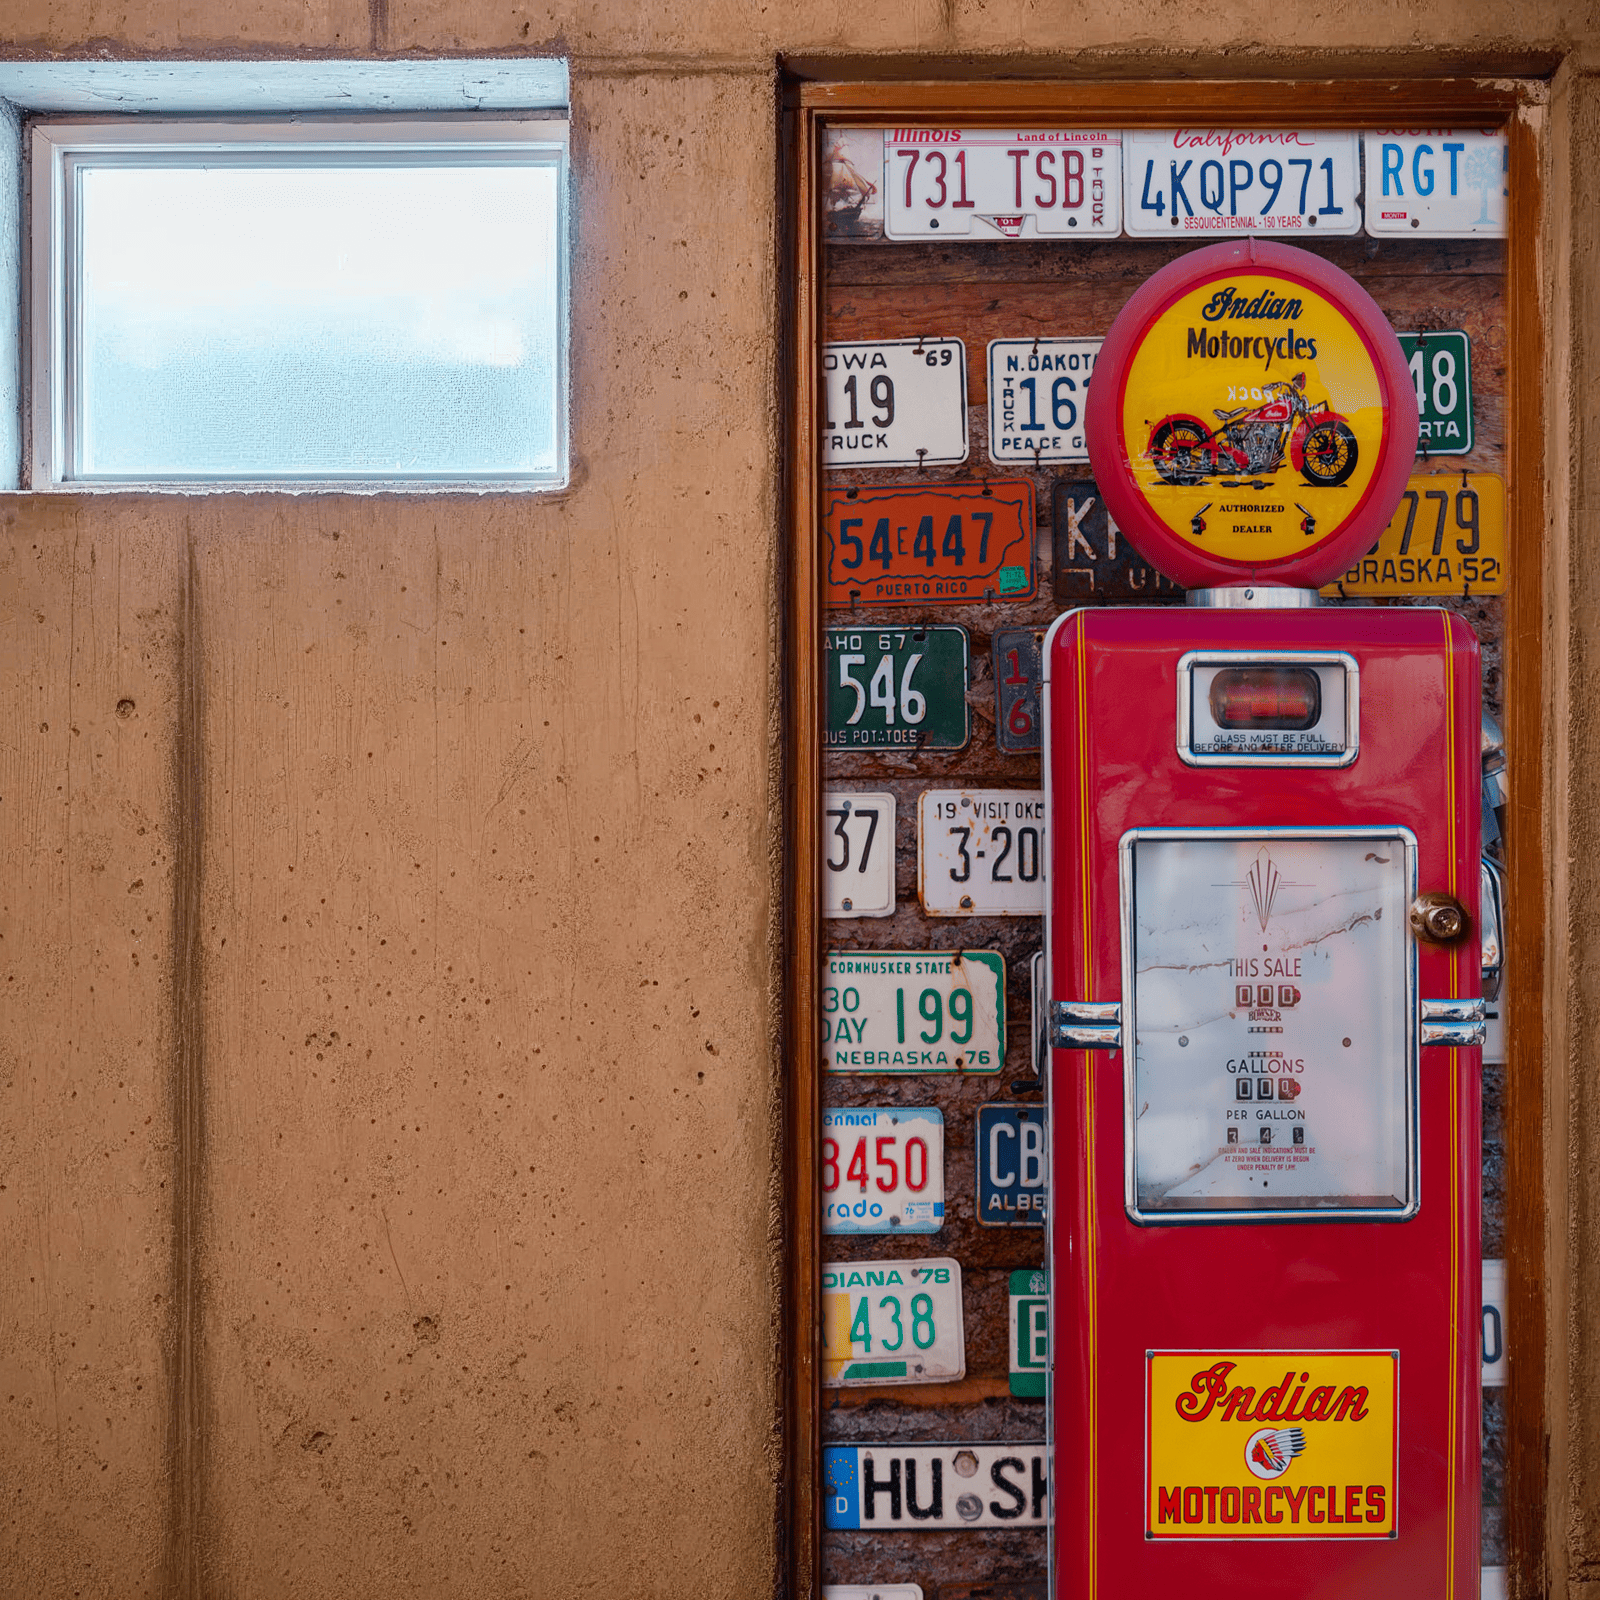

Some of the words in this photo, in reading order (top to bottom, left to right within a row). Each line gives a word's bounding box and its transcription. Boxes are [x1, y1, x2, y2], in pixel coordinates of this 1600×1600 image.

[893, 129, 962, 142] Illinois
[1017, 133, 1046, 141] Land
[1048, 132, 1060, 141] of
[1063, 132, 1108, 141] Lincoln
[1173, 129, 1316, 156] California
[897, 150, 975, 208] 731
[1007, 150, 1085, 208] TSB
[1382, 143, 1465, 197] RGT
[1141, 157, 1344, 216] 4KQP971
[1184, 216, 1258, 229] SESQUICENTENNIAL
[1263, 216, 1276, 229] 150
[1276, 215, 1302, 228] YEARS
[1201, 287, 1303, 321] Indian
[925, 350, 953, 366] 69
[1187, 328, 1318, 371] Motorcycles
[1020, 376, 1092, 431] 16
[1002, 437, 1061, 450] PEACE
[1219, 504, 1285, 513] AUTHORIZED
[1232, 525, 1273, 533] DEALER
[1463, 557, 1498, 582] 52
[876, 582, 930, 596] PUERTO
[936, 581, 968, 594] RICO
[878, 634, 906, 650] 67
[839, 654, 927, 725] 546
[1195, 743, 1234, 751] BEFORE
[1261, 743, 1293, 751] AFTER
[1299, 743, 1344, 751] DELIVERY
[1213, 734, 1247, 743] GLASS
[1250, 734, 1279, 743] MUST
[1282, 734, 1296, 743] BE
[1300, 734, 1326, 743] FULL
[936, 803, 956, 819] 19
[973, 802, 1010, 819] VISIT
[826, 809, 879, 873] 37
[949, 826, 1046, 883] 3-20
[830, 961, 911, 974] CORNHUSKER
[916, 961, 952, 974] STATE
[1227, 958, 1259, 977] THIS
[1263, 958, 1302, 977] SALE
[823, 987, 860, 1013] 30
[896, 987, 974, 1044] 199
[836, 1050, 949, 1065] NEBRASKA
[965, 1050, 990, 1065] 76
[1226, 1059, 1304, 1074] GALLONS
[1226, 1109, 1248, 1120] PER
[1255, 1109, 1306, 1120] GALLON
[989, 1122, 1045, 1188] CB
[1224, 1155, 1231, 1163] AT
[1246, 1155, 1261, 1163] WHEN
[1262, 1155, 1285, 1163] DELIVERY
[1286, 1155, 1292, 1163] IS
[918, 1268, 951, 1285] 78
[849, 1293, 936, 1353] 438
[1175, 1361, 1370, 1422] Indian
[863, 1457, 944, 1520] HU
[835, 1496, 848, 1514] D
[1158, 1485, 1386, 1524] MOTORCYCLES
